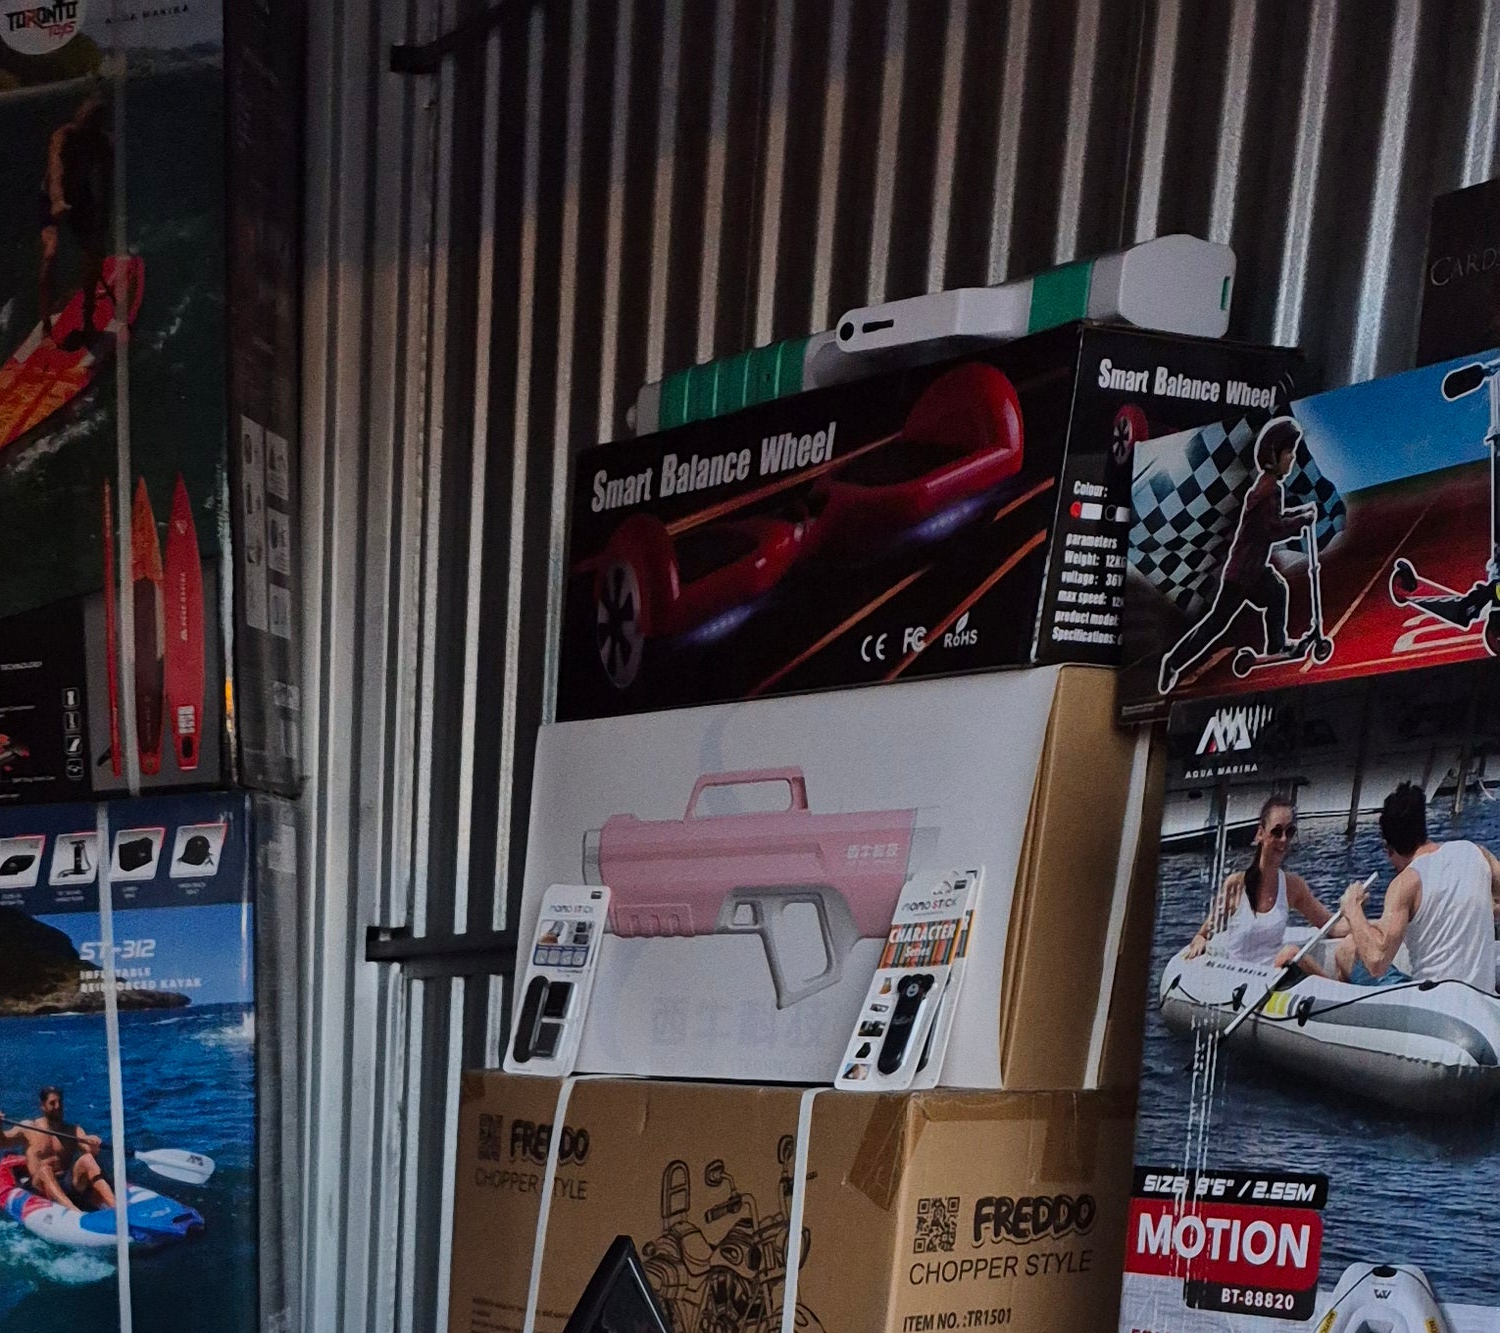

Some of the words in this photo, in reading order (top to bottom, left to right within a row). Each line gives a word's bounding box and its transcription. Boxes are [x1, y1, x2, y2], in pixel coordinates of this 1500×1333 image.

[1099, 358, 1150, 395] Smart
[1154, 367, 1220, 403] Balance
[1226, 381, 1277, 409] Wheel
[591, 467, 653, 513] Smart
[659, 453, 750, 499] Balance
[760, 421, 837, 477] Wheel
[1074, 480, 1108, 498] Colour:
[1065, 533, 1118, 549] parameters
[1064, 550, 1099, 567] Weight:
[1058, 589, 1077, 603] max
[1185, 769, 1214, 779] AQUA
[1217, 763, 1258, 776] MARINA
[889, 924, 956, 944] CHARACTER
[509, 1118, 591, 1167] FREDO
[475, 1167, 540, 1194] CHOPPER
[553, 1176, 590, 1201] TYLE
[1252, 1181, 1317, 1202] 2.55M
[971, 1194, 1097, 1249] FREDDO
[1137, 1212, 1311, 1270] MOTION
[909, 1255, 1019, 1286] CHOPPER
[1025, 1249, 1093, 1277] STYLE
[1221, 1287, 1295, 1311] BT-88820
[903, 1315, 935, 1333] ITEM
